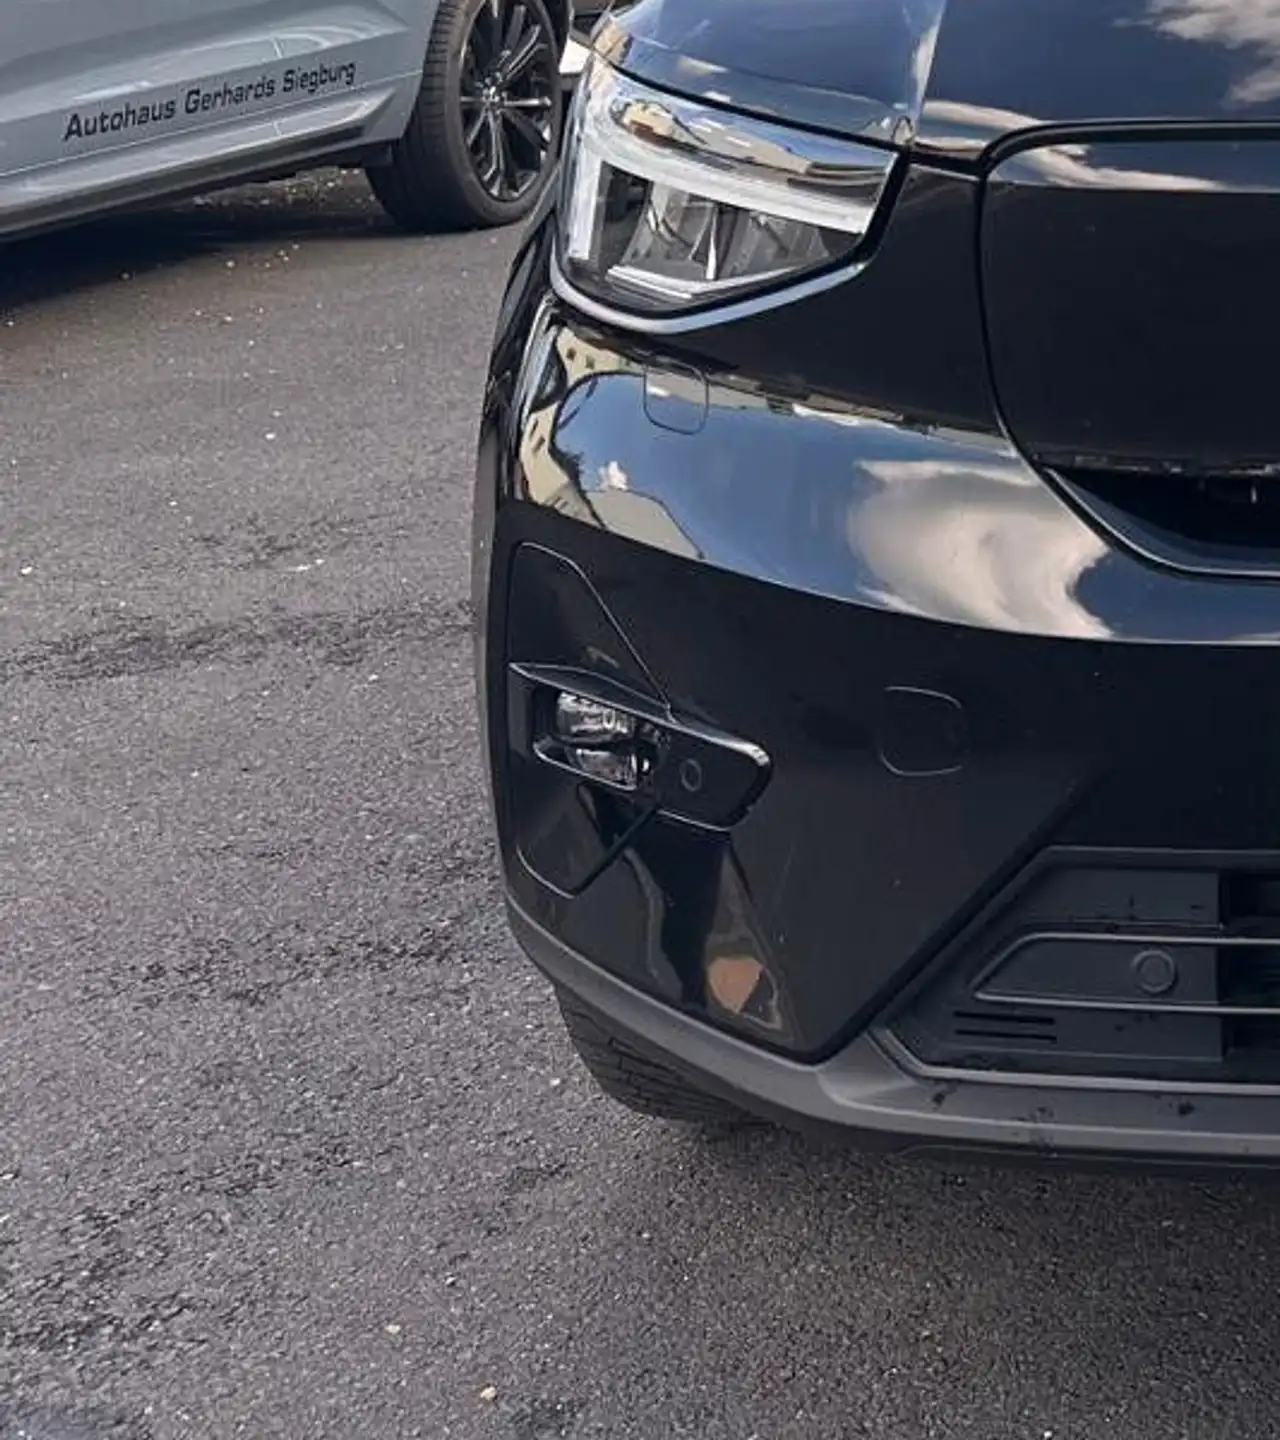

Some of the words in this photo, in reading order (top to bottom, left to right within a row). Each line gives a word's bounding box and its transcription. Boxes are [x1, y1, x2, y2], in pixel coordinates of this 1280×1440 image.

[64, 99, 176, 141] Autohaus
[183, 78, 276, 114] Gerhards
[283, 61, 357, 93] Siegburg
